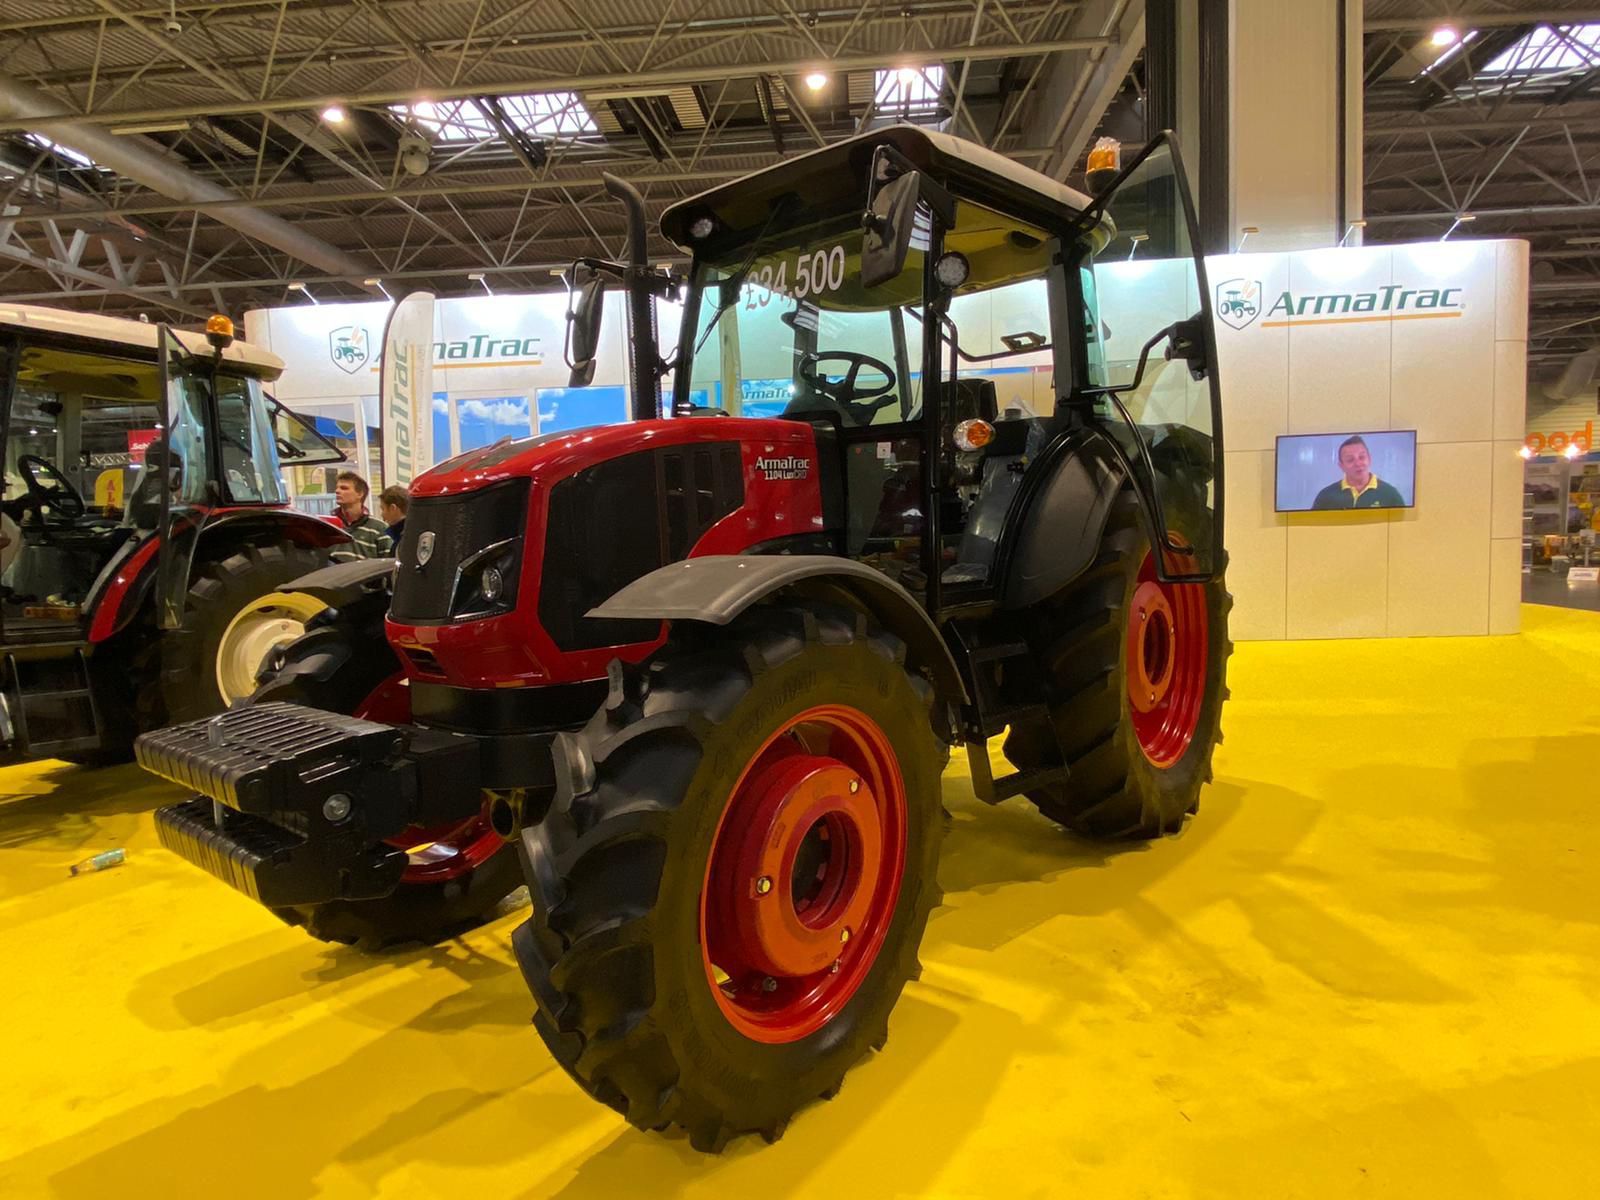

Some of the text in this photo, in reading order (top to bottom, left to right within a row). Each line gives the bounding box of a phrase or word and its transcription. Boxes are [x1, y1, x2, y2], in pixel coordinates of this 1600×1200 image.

[745, 245, 845, 311] £34,500
[1266, 285, 1462, 317] ArmaTrac
[390, 339, 412, 485] maTrac
[755, 456, 810, 470] ArmaTrac
[764, 469, 782, 480] 1104
